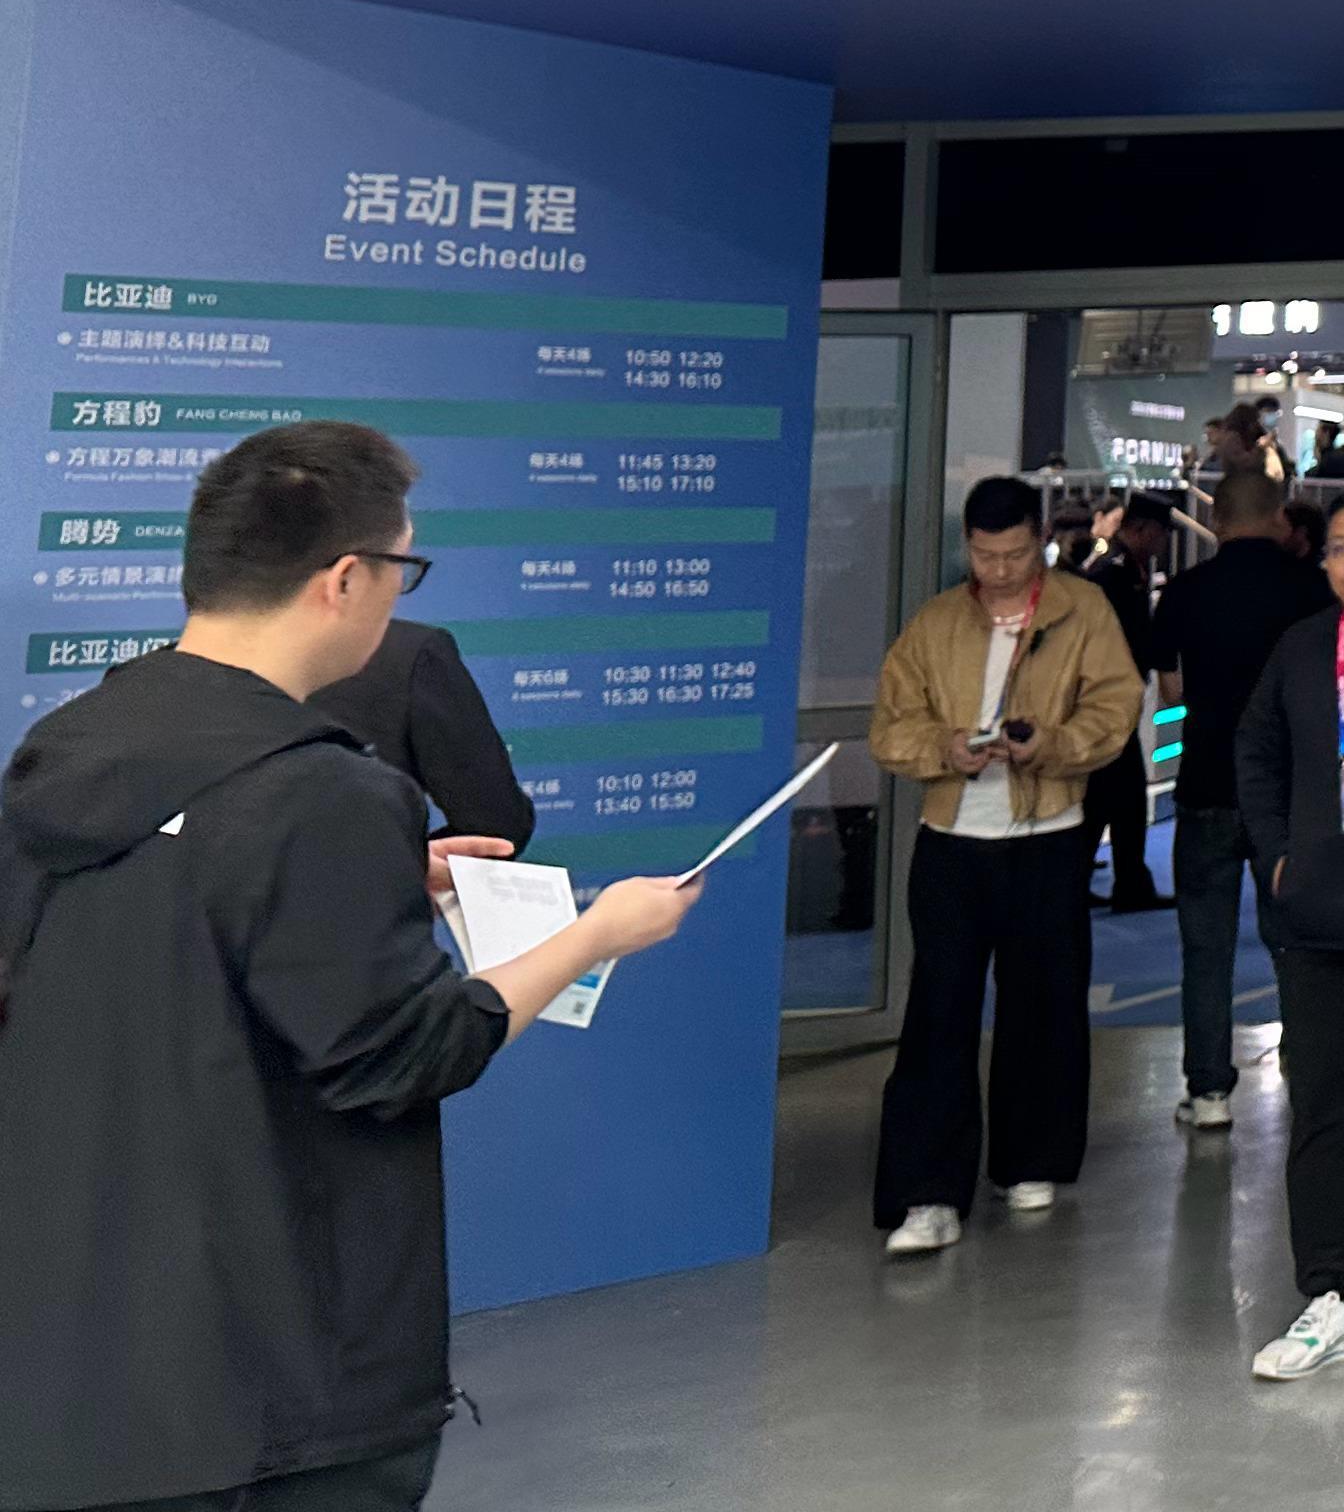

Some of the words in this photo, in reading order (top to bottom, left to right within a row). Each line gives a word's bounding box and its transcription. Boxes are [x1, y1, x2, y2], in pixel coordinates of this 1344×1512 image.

[342, 171, 577, 234] 活动日程
[324, 234, 425, 266] Event
[435, 240, 587, 273] Schedule
[84, 281, 173, 310] 比亚迪
[679, 351, 724, 368] 12:20
[624, 370, 671, 388] 14:30
[72, 400, 162, 426] 方程豹
[176, 408, 216, 420] FANG
[271, 409, 302, 422] BAO
[671, 454, 717, 471] 13:20
[1111, 437, 1184, 467] FORMUL
[671, 475, 715, 492] 17:10
[59, 519, 120, 545] 腾势
[134, 525, 185, 538] DENZA
[612, 559, 658, 576] 11:10
[665, 558, 711, 576] 13:00
[48, 637, 179, 666] 比亚迪
[603, 665, 650, 684] 10:30
[659, 663, 703, 681] 11:30
[711, 661, 756, 678] 12:40
[597, 773, 644, 792] 10:10
[651, 770, 697, 788] 12:00
[595, 796, 641, 815] 13:40
